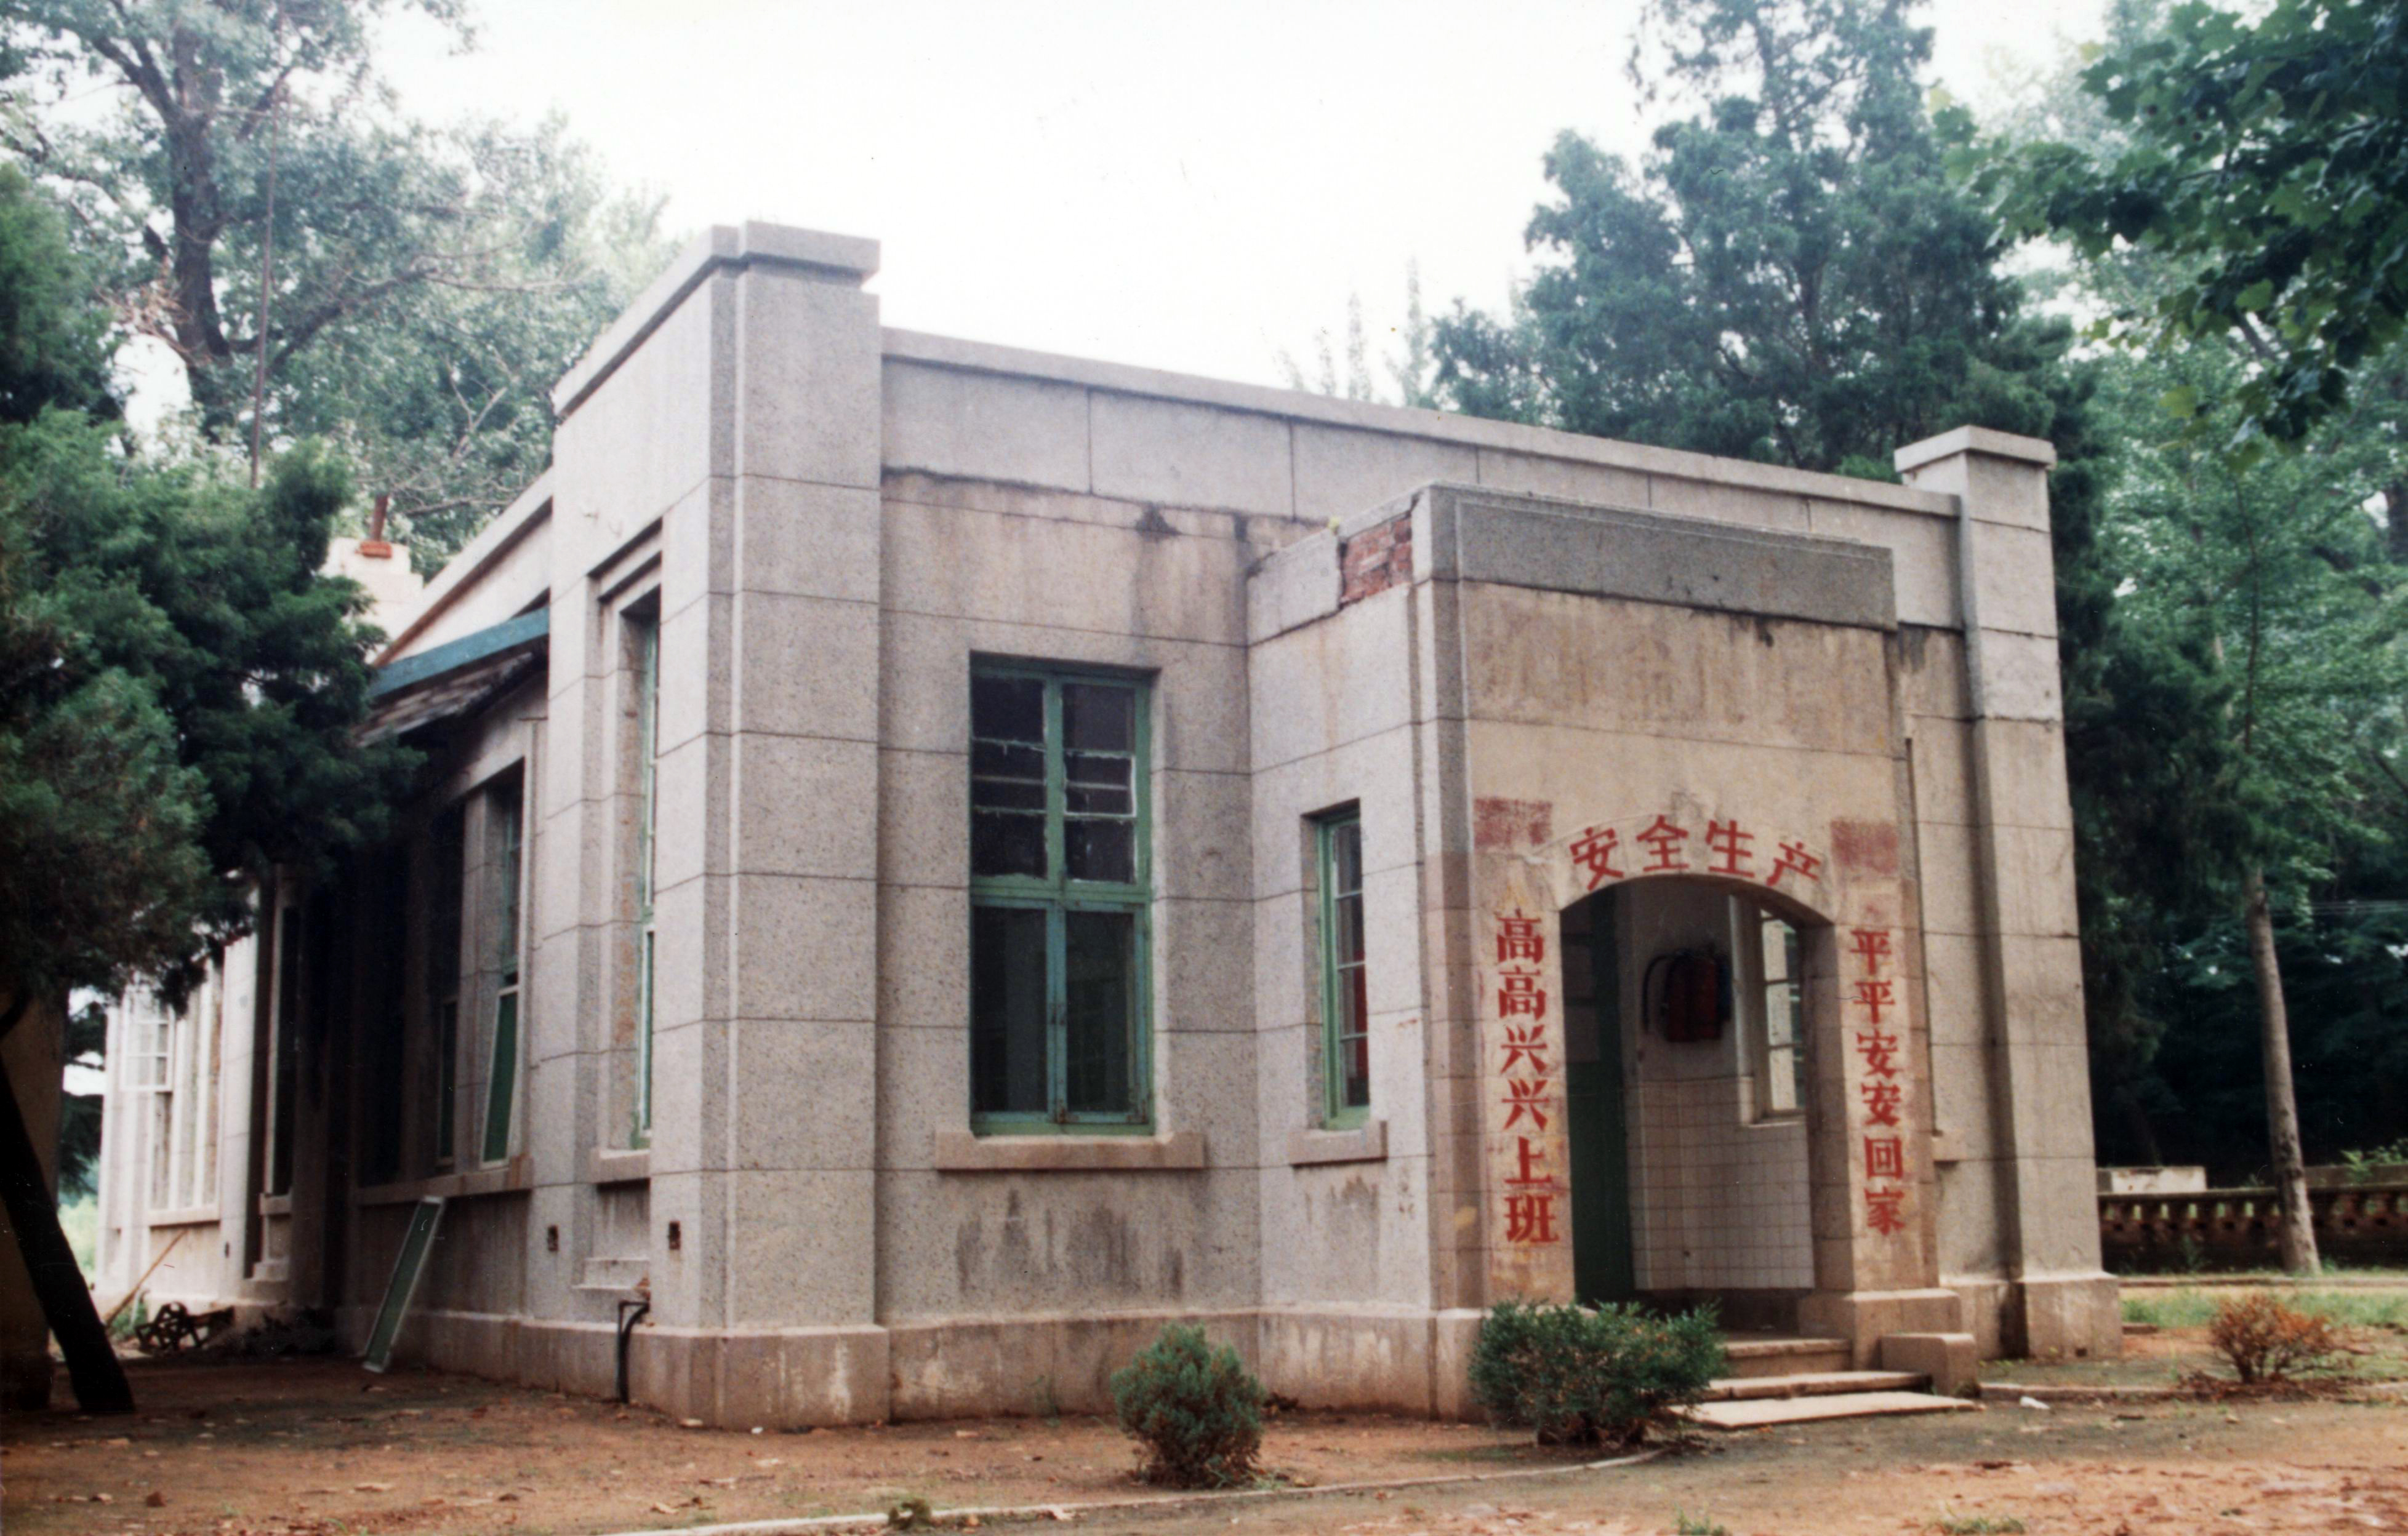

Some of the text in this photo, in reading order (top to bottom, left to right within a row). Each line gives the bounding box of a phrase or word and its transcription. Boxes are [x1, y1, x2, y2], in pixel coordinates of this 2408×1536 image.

[1570, 815, 1820, 890] 安全生产
[1495, 910, 1559, 1244] 高高兴兴上班
[1850, 929, 1906, 1236] 平平安安回家
